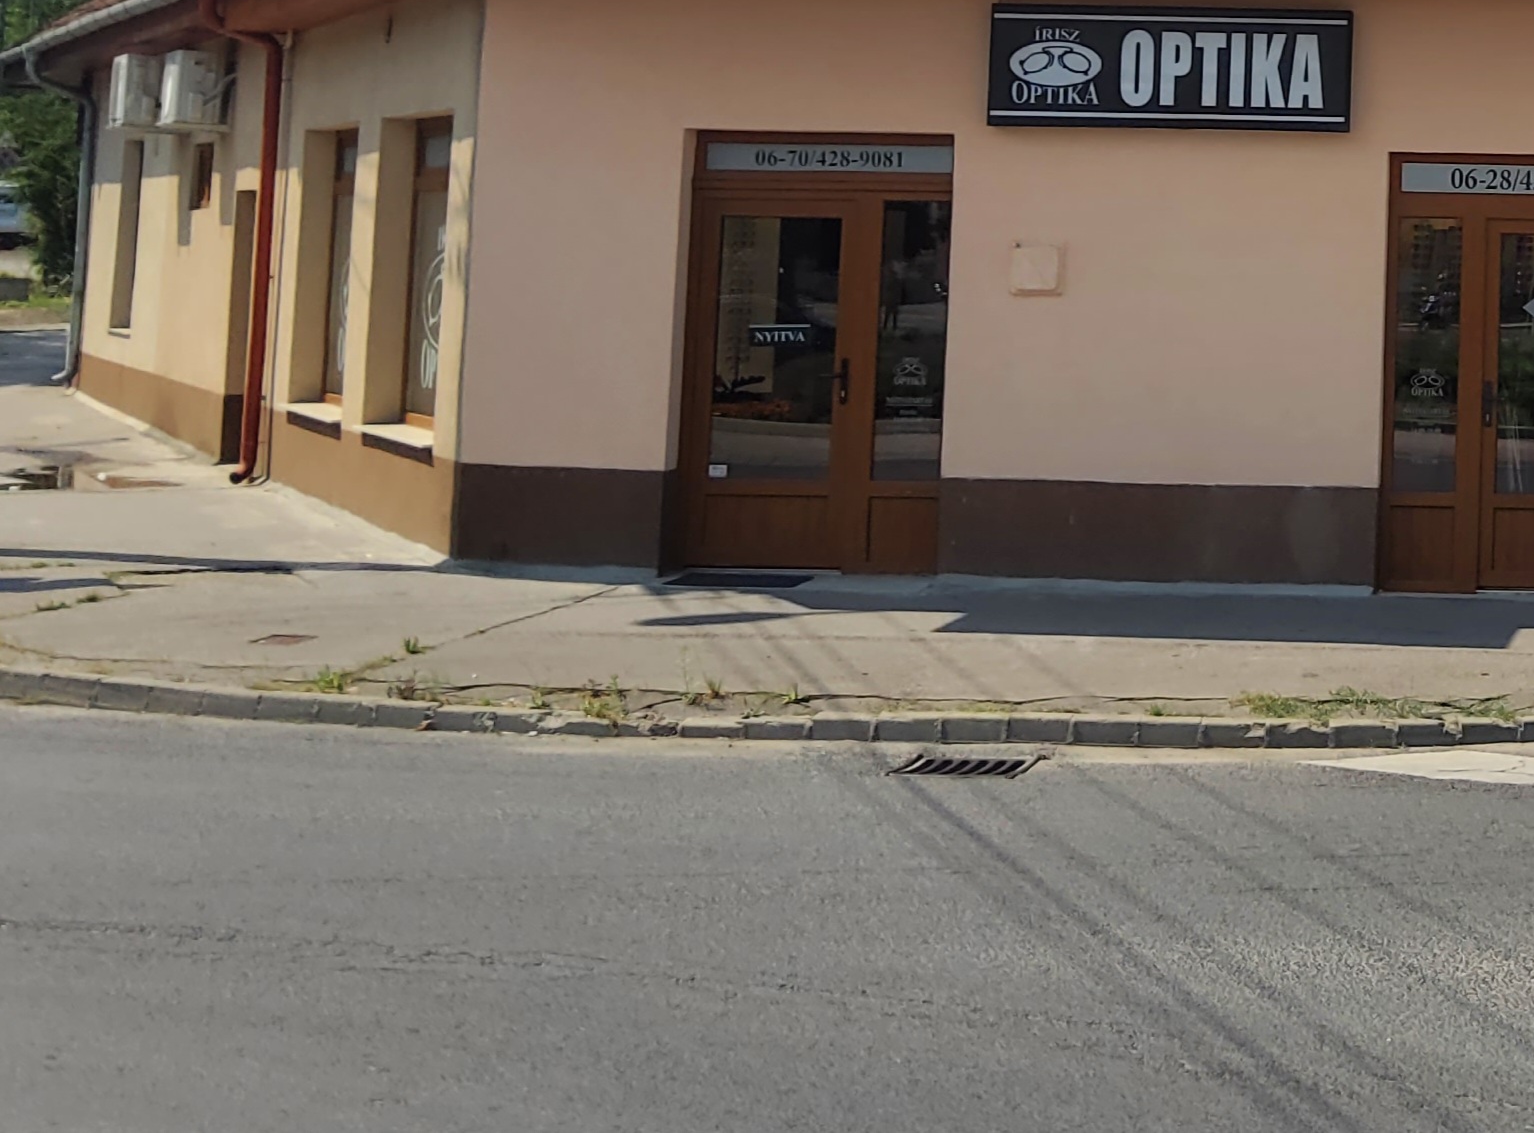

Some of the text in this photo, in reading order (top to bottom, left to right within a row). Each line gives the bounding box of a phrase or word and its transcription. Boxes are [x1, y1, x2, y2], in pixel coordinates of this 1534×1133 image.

[1034, 26, 1081, 42] ÍRISZ
[1120, 29, 1325, 110] OPTIKA
[1011, 80, 1100, 106] OPTIKA
[755, 149, 904, 168] 06-70/428-9081
[754, 331, 806, 343] NYITVA
